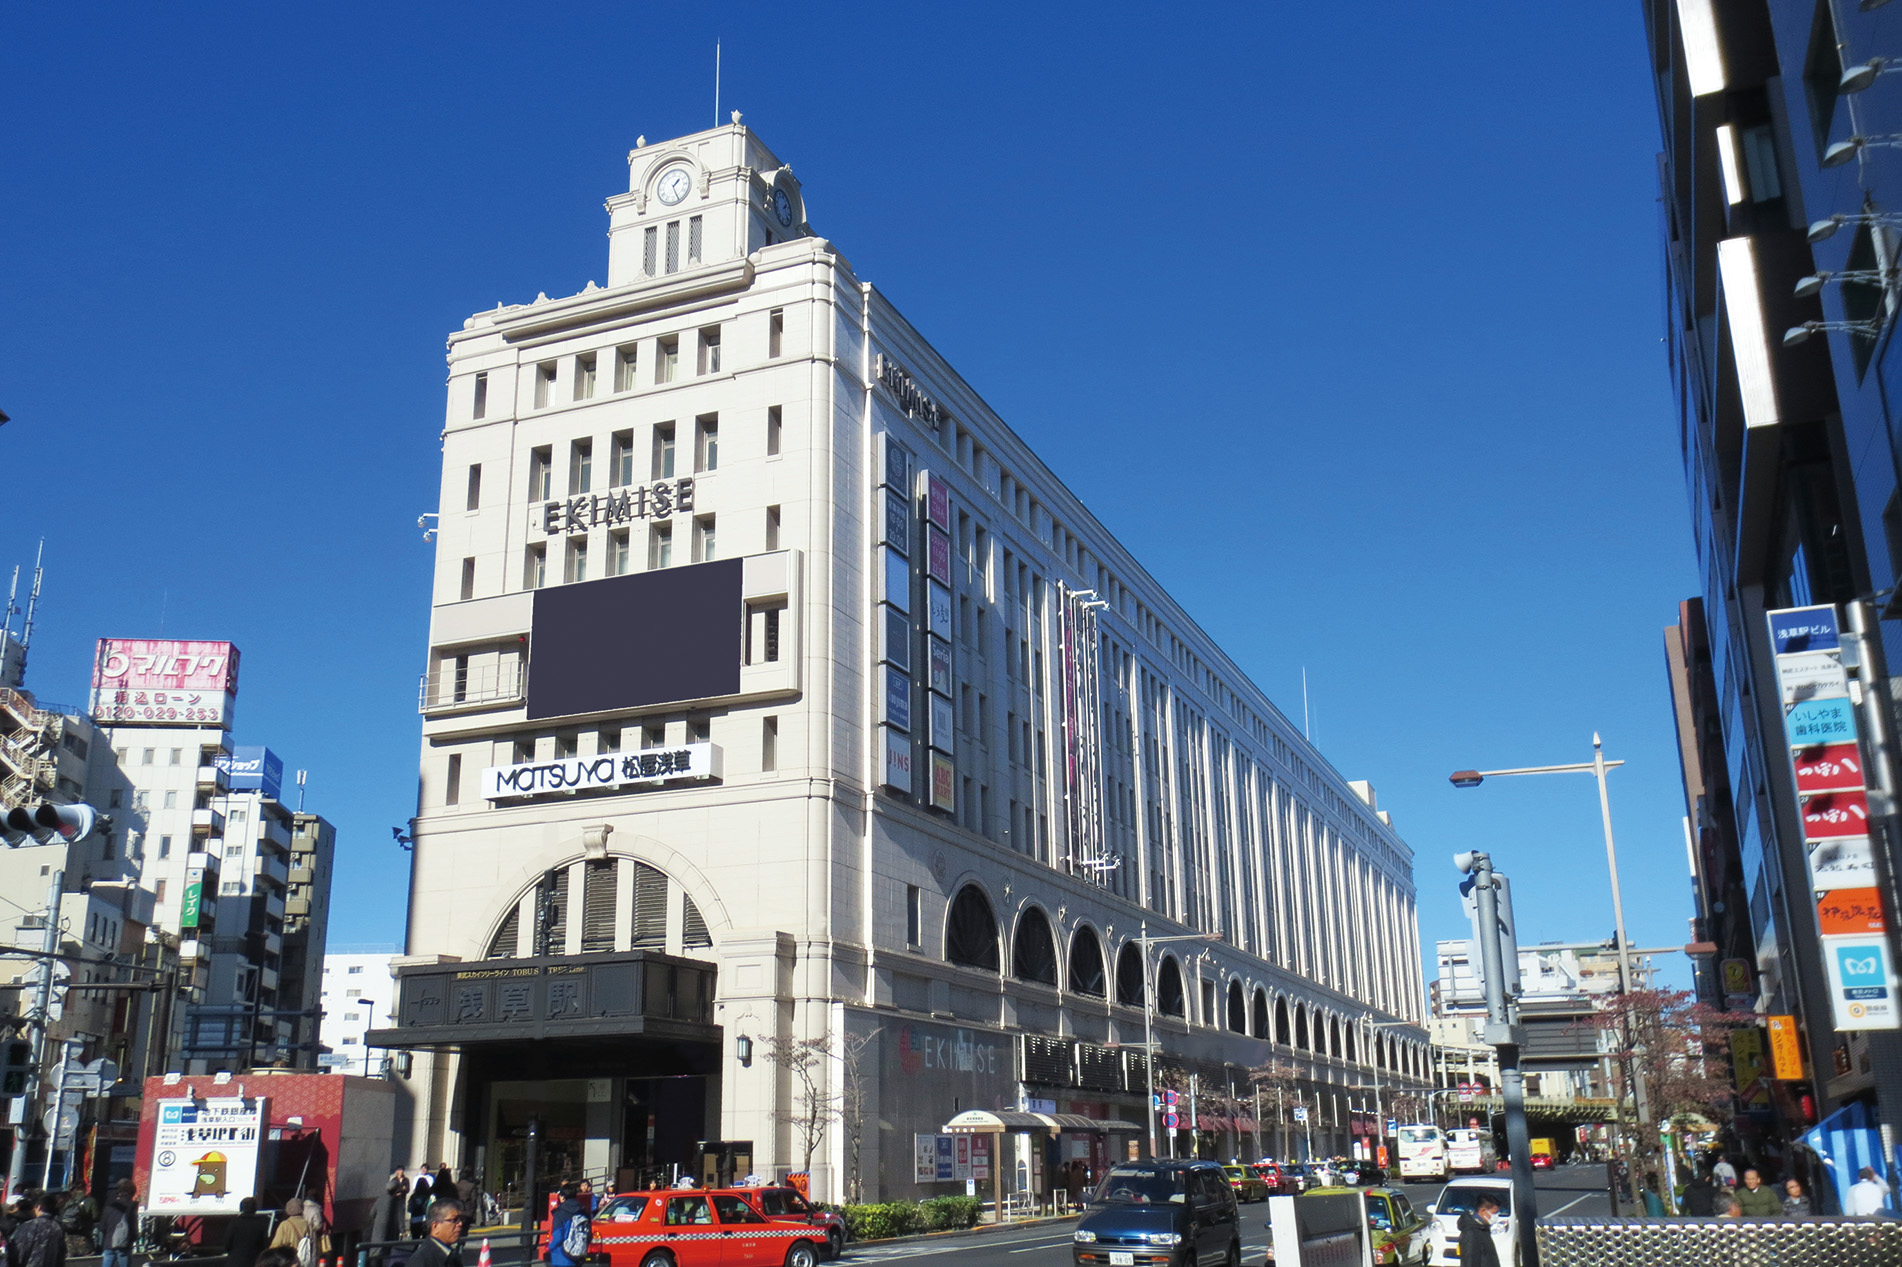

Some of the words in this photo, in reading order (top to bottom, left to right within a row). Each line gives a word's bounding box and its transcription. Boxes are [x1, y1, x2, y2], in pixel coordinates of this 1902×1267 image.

[543, 477, 693, 533] EKIMISE
[1777, 624, 1831, 639] 浅草駅ビル
[133, 654, 226, 677] マルフク
[115, 691, 202, 706] 振込ローン
[94, 706, 219, 721] 0120-029-253
[1794, 707, 1842, 721] いしやま
[1795, 720, 1848, 736] 歯科医院
[622, 750, 691, 779] 松屋浅草
[1797, 758, 1858, 777] つぼ八
[1804, 804, 1867, 824] つぼ八
[186, 890, 198, 916] レイク
[459, 984, 579, 1019] 浅草駅
